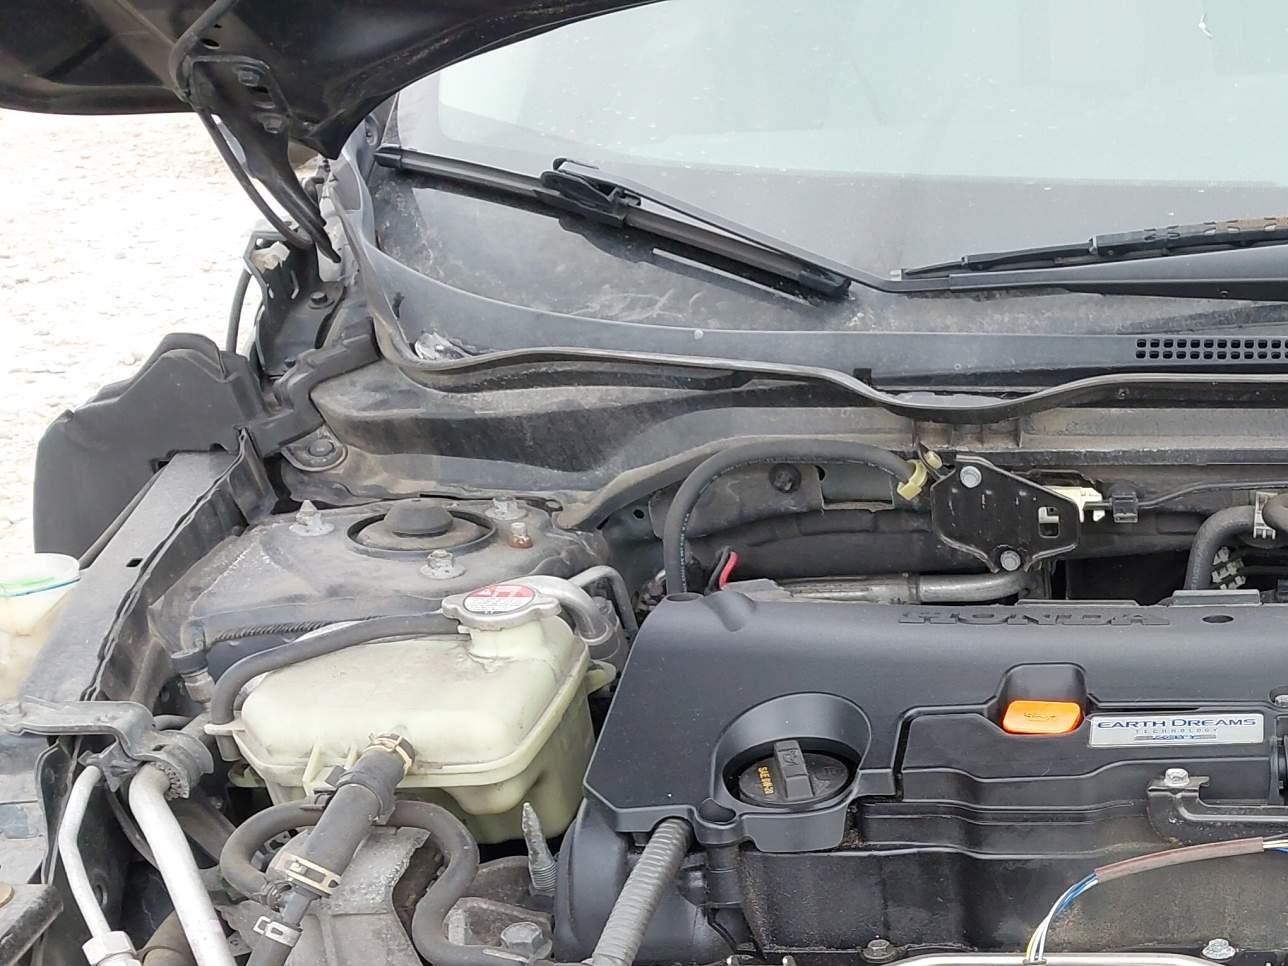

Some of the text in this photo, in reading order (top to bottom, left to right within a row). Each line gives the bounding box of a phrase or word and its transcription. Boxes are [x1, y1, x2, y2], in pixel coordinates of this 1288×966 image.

[897, 611, 1171, 626] HONDA
[1097, 718, 1257, 729] EARTH DREAMS
